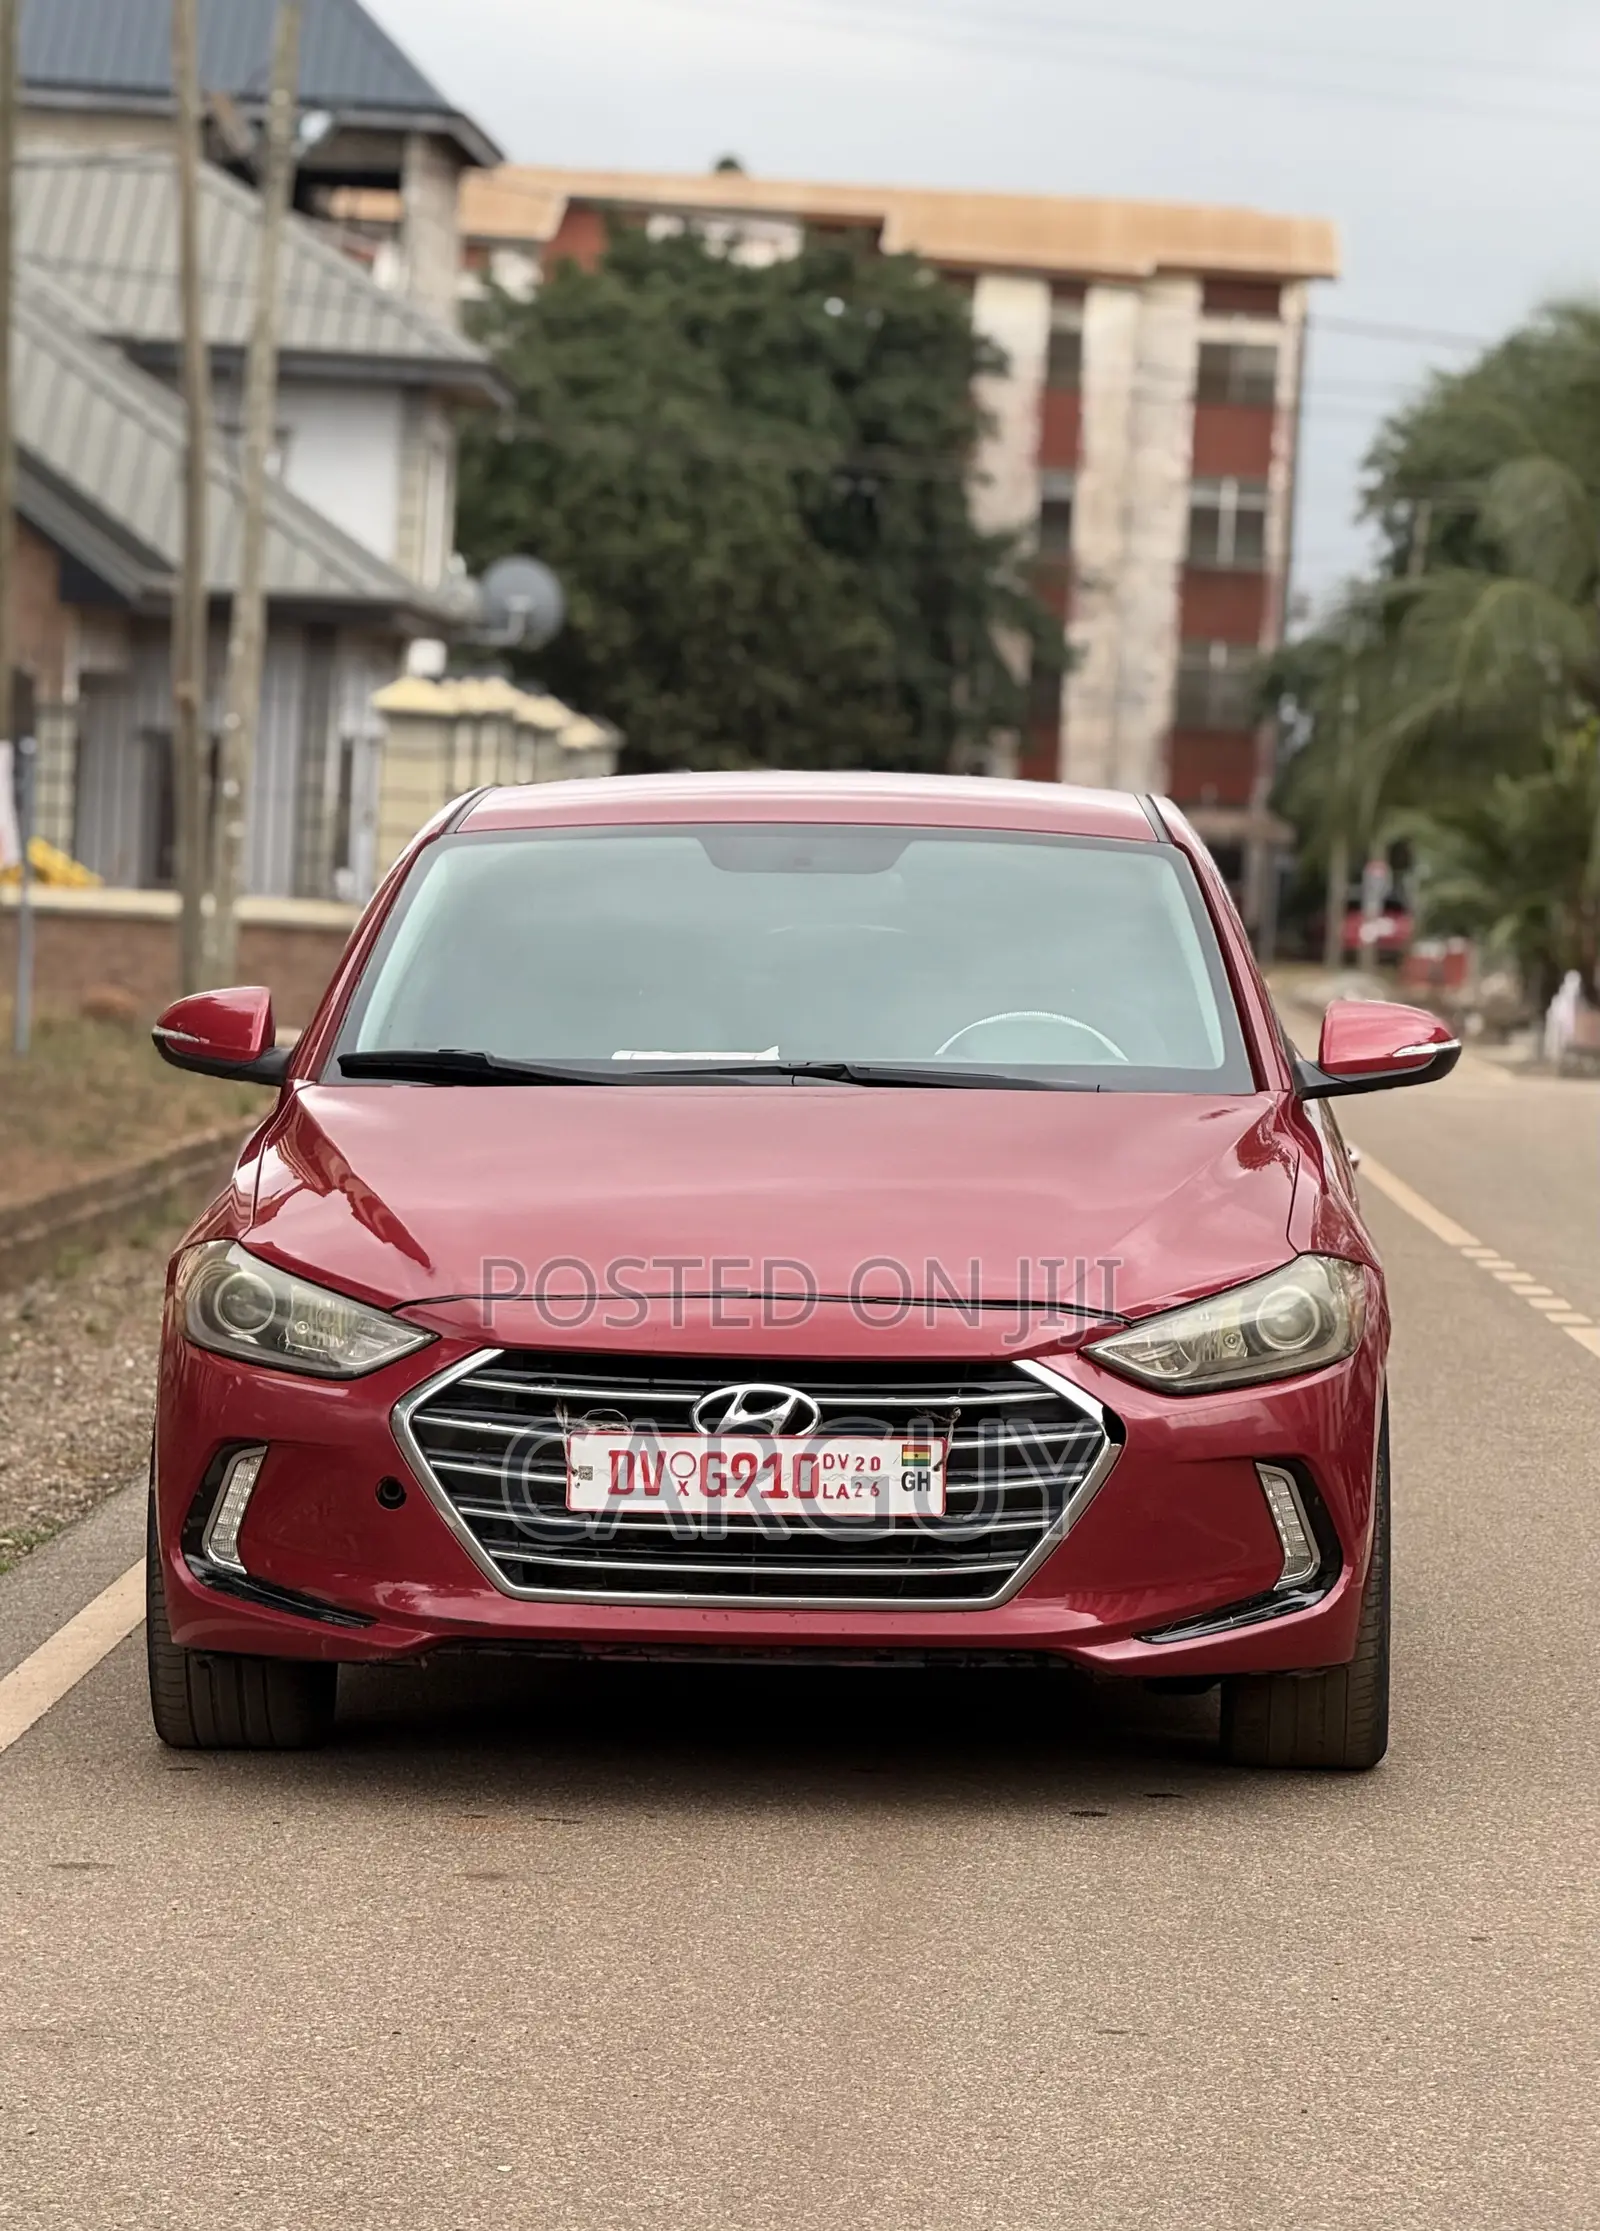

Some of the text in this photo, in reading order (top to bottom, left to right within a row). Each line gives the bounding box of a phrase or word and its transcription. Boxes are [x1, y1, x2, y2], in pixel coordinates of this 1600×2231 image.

[823, 1453, 849, 1470] DV
[608, 1450, 666, 1496] DV
[901, 1471, 930, 1492] GH
[823, 1483, 850, 1499] LA
